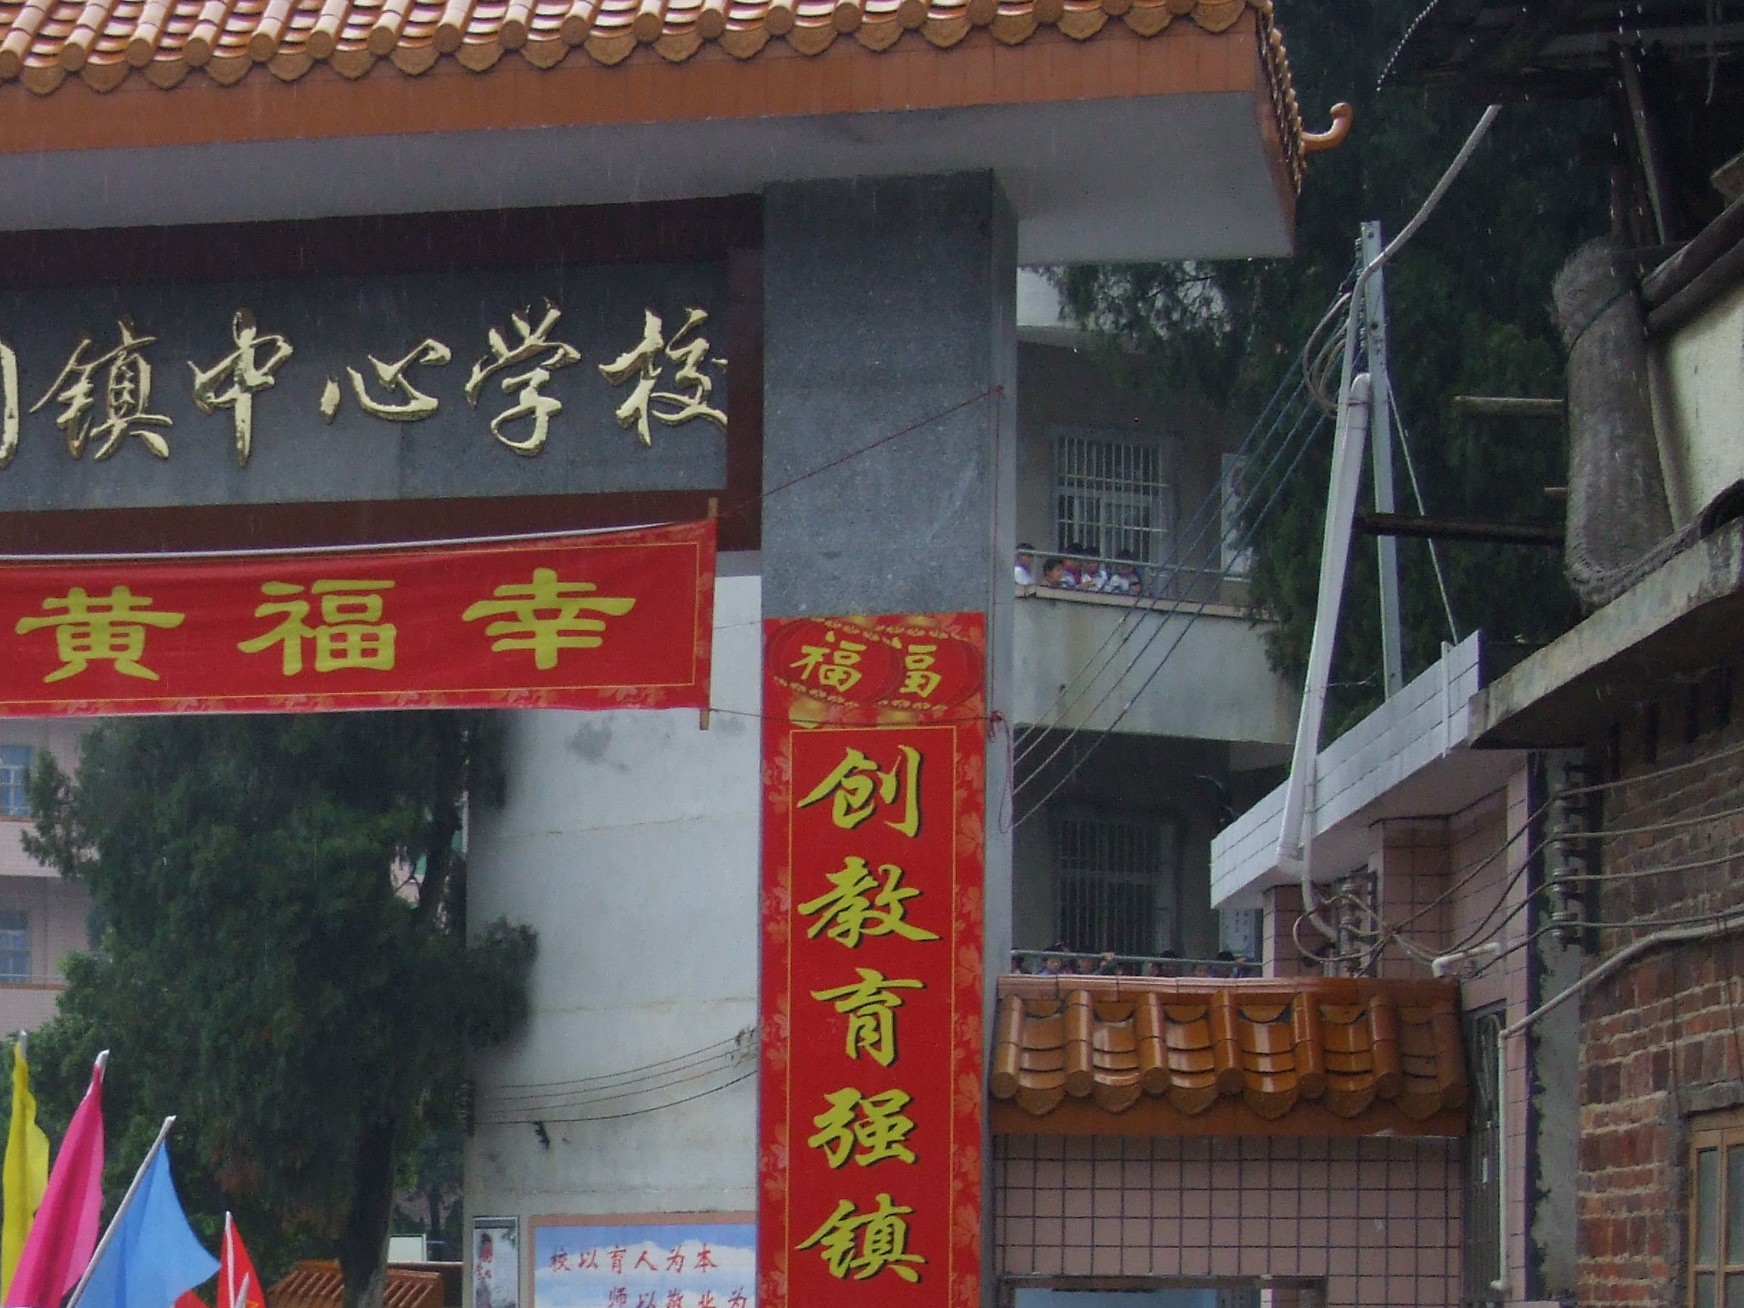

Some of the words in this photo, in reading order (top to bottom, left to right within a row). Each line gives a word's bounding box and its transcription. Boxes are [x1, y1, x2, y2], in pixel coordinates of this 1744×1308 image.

[549, 1245, 720, 1275] 校以育人为本
